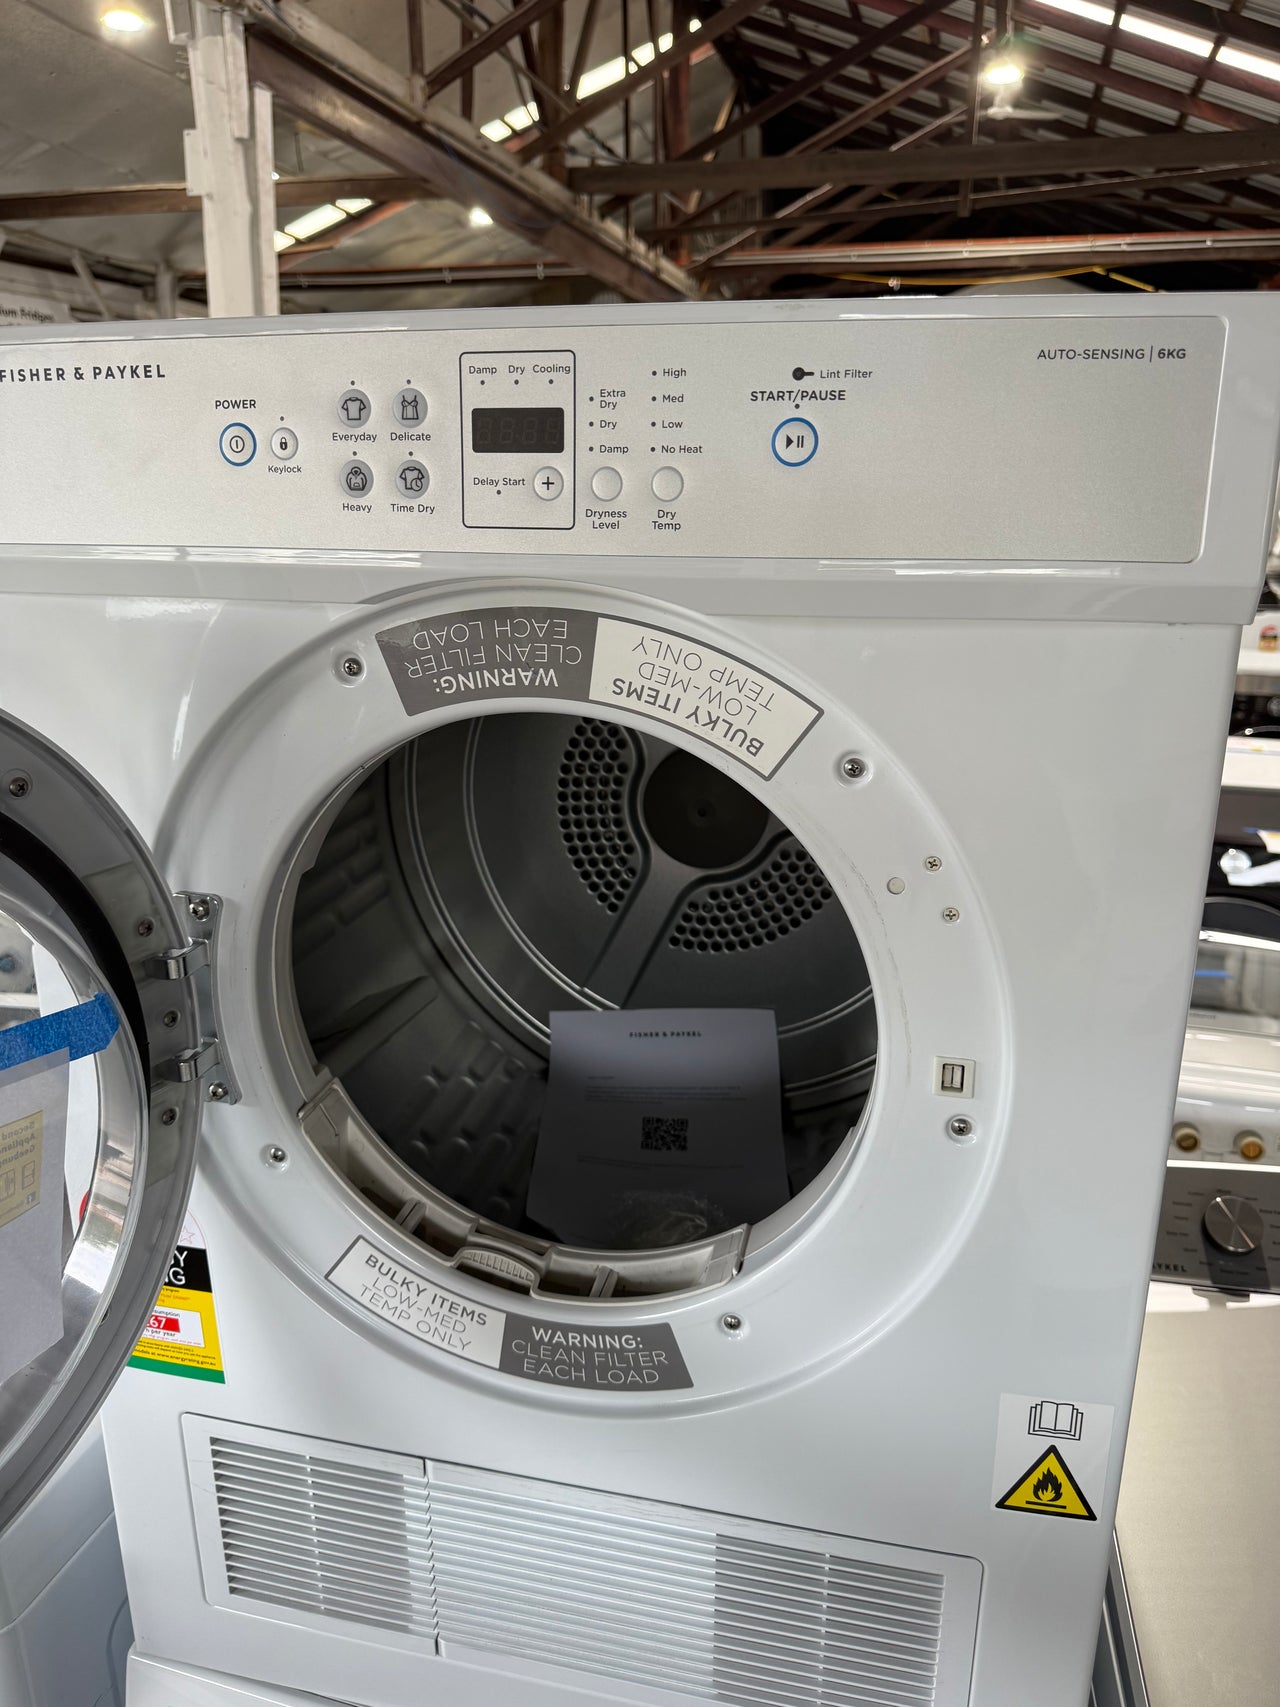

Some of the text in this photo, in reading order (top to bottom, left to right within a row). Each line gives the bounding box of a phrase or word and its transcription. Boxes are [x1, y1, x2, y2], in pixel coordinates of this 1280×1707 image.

[1037, 347, 1187, 361] AUTO-SENSING 6KG
[0, 364, 165, 382] FISHER & PAYKEL
[468, 365, 498, 376] Damp
[508, 365, 526, 376] Dry
[532, 364, 571, 375] Cooling
[662, 368, 687, 378] High
[819, 368, 873, 380] Lint Filter
[600, 389, 626, 398] Extra
[662, 394, 684, 403] Med
[750, 389, 846, 402] START/PAUSE
[215, 399, 257, 409] POWER
[600, 400, 618, 410] Dry
[600, 420, 618, 430] Dry
[661, 420, 684, 429] Low
[332, 432, 377, 443] Everyday
[390, 432, 431, 442] Delicate
[599, 444, 629, 455] Damp
[661, 444, 703, 454] No Heat
[268, 464, 302, 475] Keylock
[473, 477, 526, 488] Delay Start
[342, 503, 372, 513] Heavy
[390, 503, 436, 514] Time Dry
[585, 508, 628, 520] Dryness
[657, 509, 677, 521] Dry
[592, 520, 620, 530] Level
[652, 521, 682, 532] Temp
[412, 618, 568, 650] EACH LOAD
[404, 642, 583, 679] CLEAN FILTER
[631, 635, 775, 713] TEMP ONLY
[435, 667, 559, 694] WARNING:
[638, 661, 758, 726] LOW-MED
[612, 677, 765, 757] BULKY ITEMS
[364, 1253, 488, 1326] BULKY ITEMS
[372, 1276, 467, 1334] LOW-MED
[359, 1283, 472, 1351] TEMP ONLY
[532, 1326, 643, 1349] WARNING:
[511, 1339, 669, 1366] CLEAN FILTER
[523, 1358, 660, 1384] EACH LOAD
